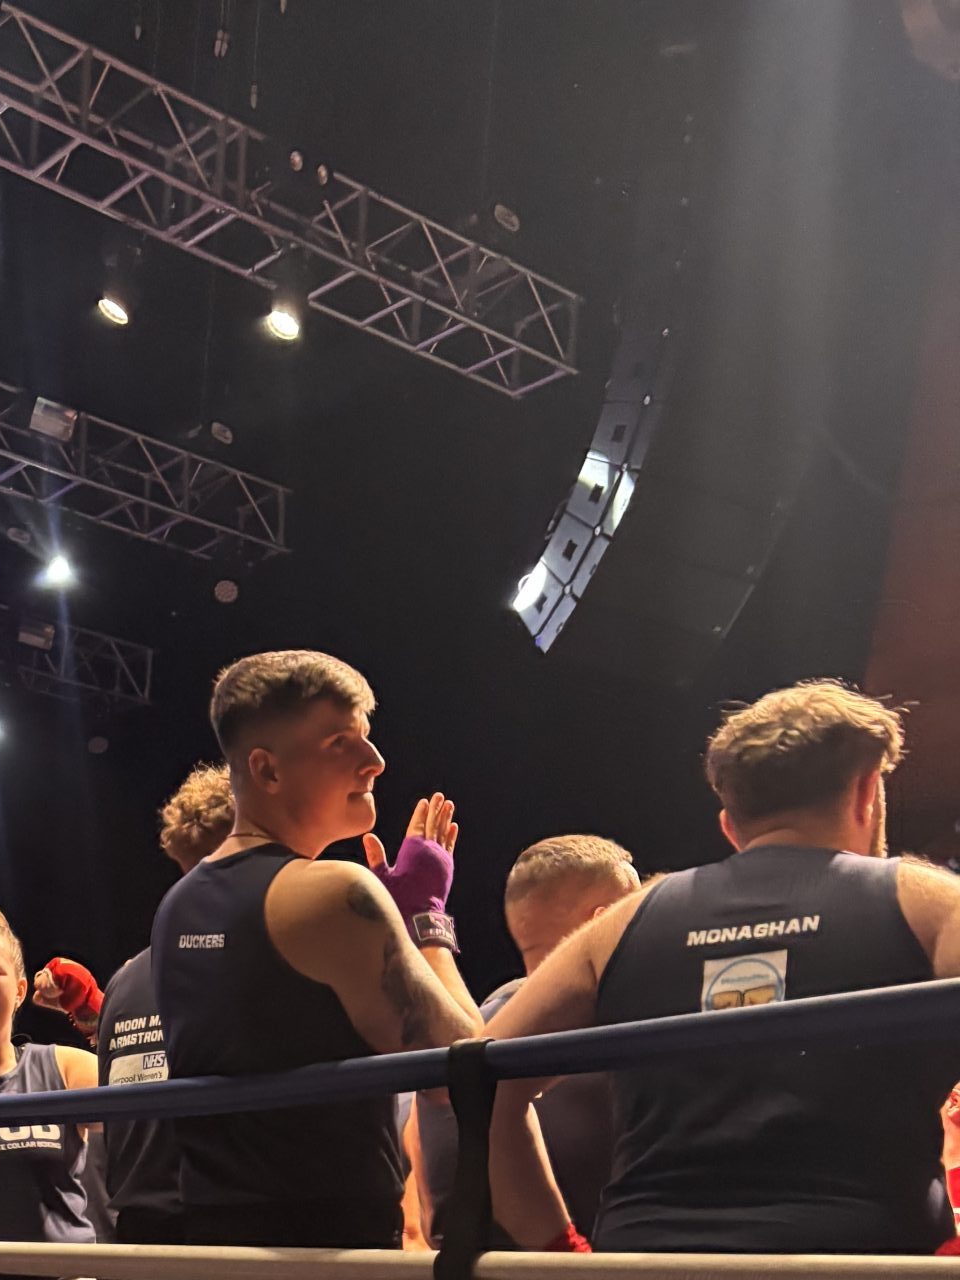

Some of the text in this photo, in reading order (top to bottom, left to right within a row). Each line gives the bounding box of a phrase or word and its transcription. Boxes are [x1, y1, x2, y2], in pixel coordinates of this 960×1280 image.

[686, 914, 821, 946] MONAGHAN
[178, 933, 226, 949] DUCKERS
[114, 1015, 161, 1034] MOON M
[143, 1053, 165, 1068] NHS
[7, 1141, 37, 1151] COLLAR
